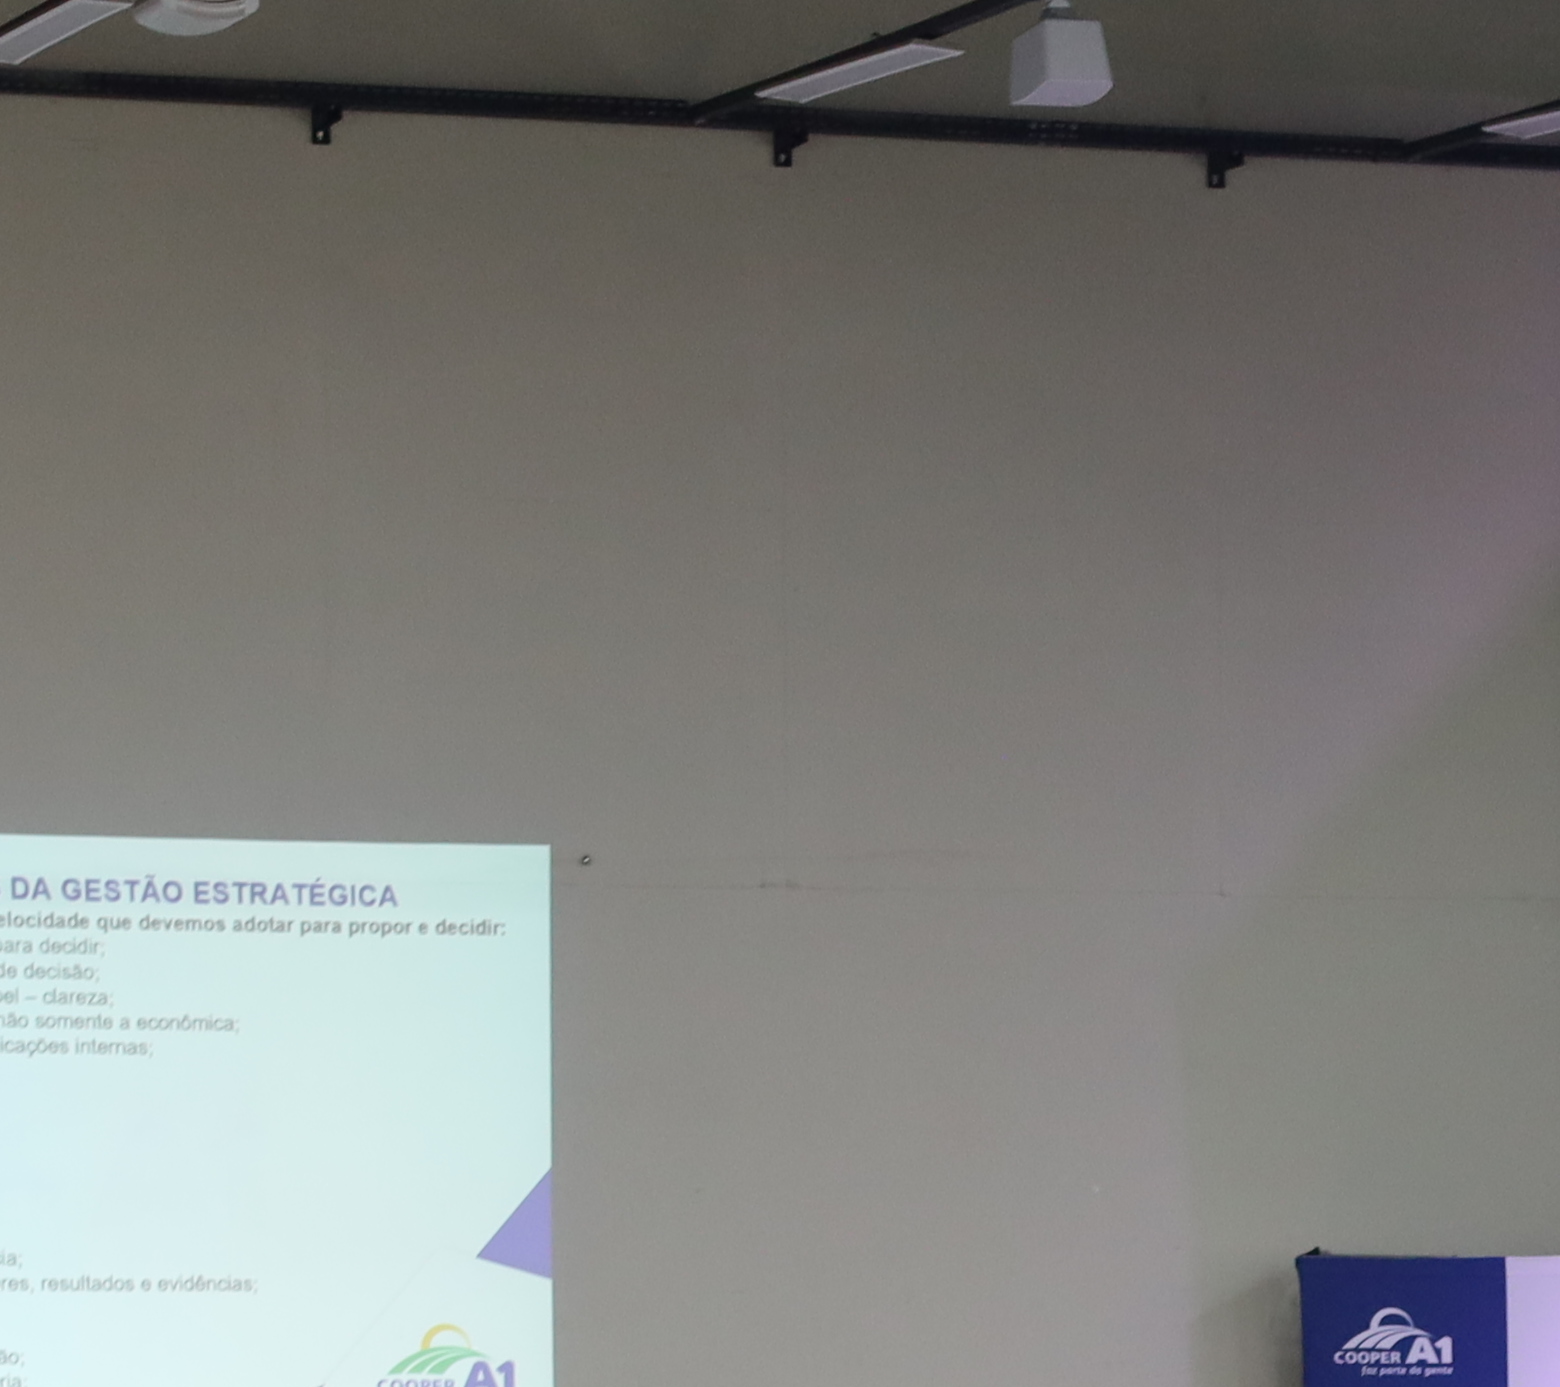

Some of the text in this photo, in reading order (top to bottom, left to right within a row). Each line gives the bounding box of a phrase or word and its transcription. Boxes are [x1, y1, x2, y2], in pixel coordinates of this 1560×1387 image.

[11, 877, 51, 900] DA
[61, 874, 182, 903] GESTÃO
[194, 877, 399, 908] ESTRATÉGICA
[96, 917, 131, 932] que
[139, 914, 226, 932] devemos
[232, 917, 294, 933] adotar
[300, 921, 341, 937] para
[348, 921, 411, 938] propor
[418, 922, 428, 934] e
[435, 919, 506, 936] decidir:
[39, 937, 106, 958] decidir;
[24, 963, 100, 982] decisão;
[43, 988, 114, 1007] clareza;
[35, 1014, 114, 1030] somente
[119, 1017, 131, 1031] a
[137, 1012, 240, 1032] econômica;
[76, 1040, 153, 1059] internas;
[41, 1276, 134, 1293] resultados
[141, 1279, 151, 1292] e
[158, 1274, 258, 1293] evidências;
[1333, 1336, 1453, 1364] COOPER A1
